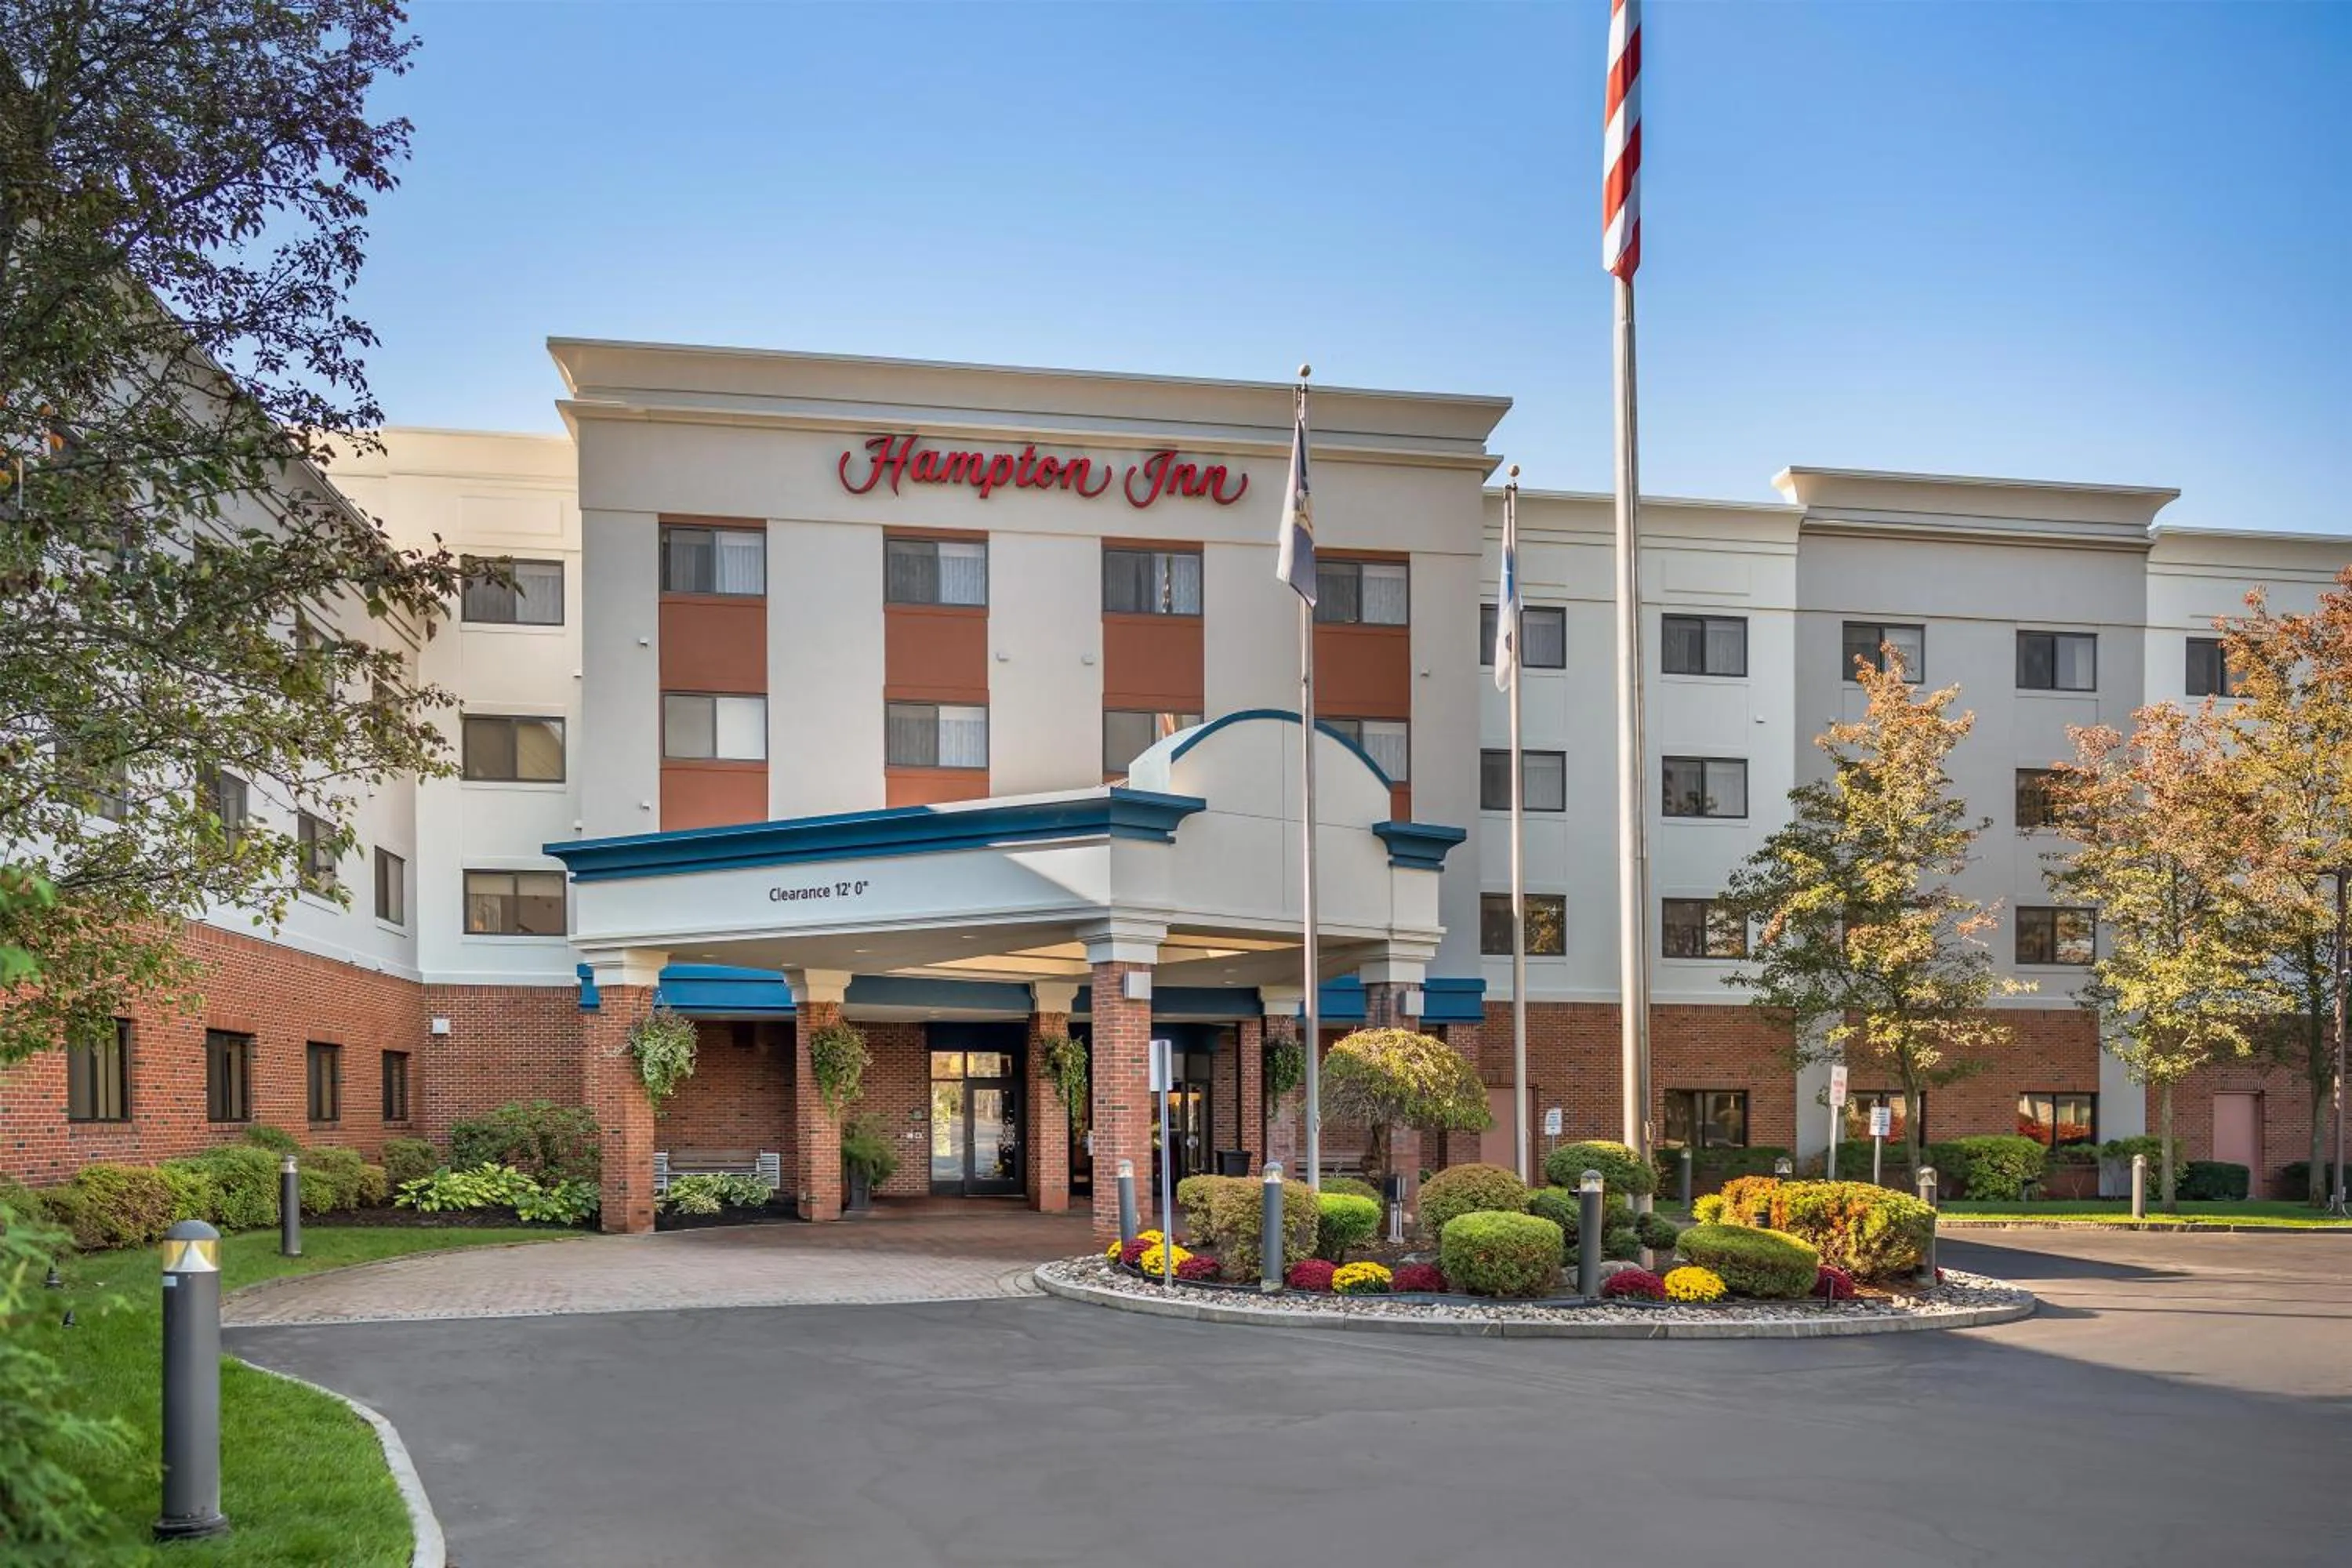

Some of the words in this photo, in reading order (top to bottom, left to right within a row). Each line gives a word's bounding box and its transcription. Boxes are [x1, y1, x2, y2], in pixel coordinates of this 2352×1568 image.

[839, 434, 1112, 499] Hampton
[1124, 449, 1248, 508] Inn
[769, 887, 830, 902] Clearance
[835, 882, 851, 897] 12'
[855, 880, 869, 895] 0"
